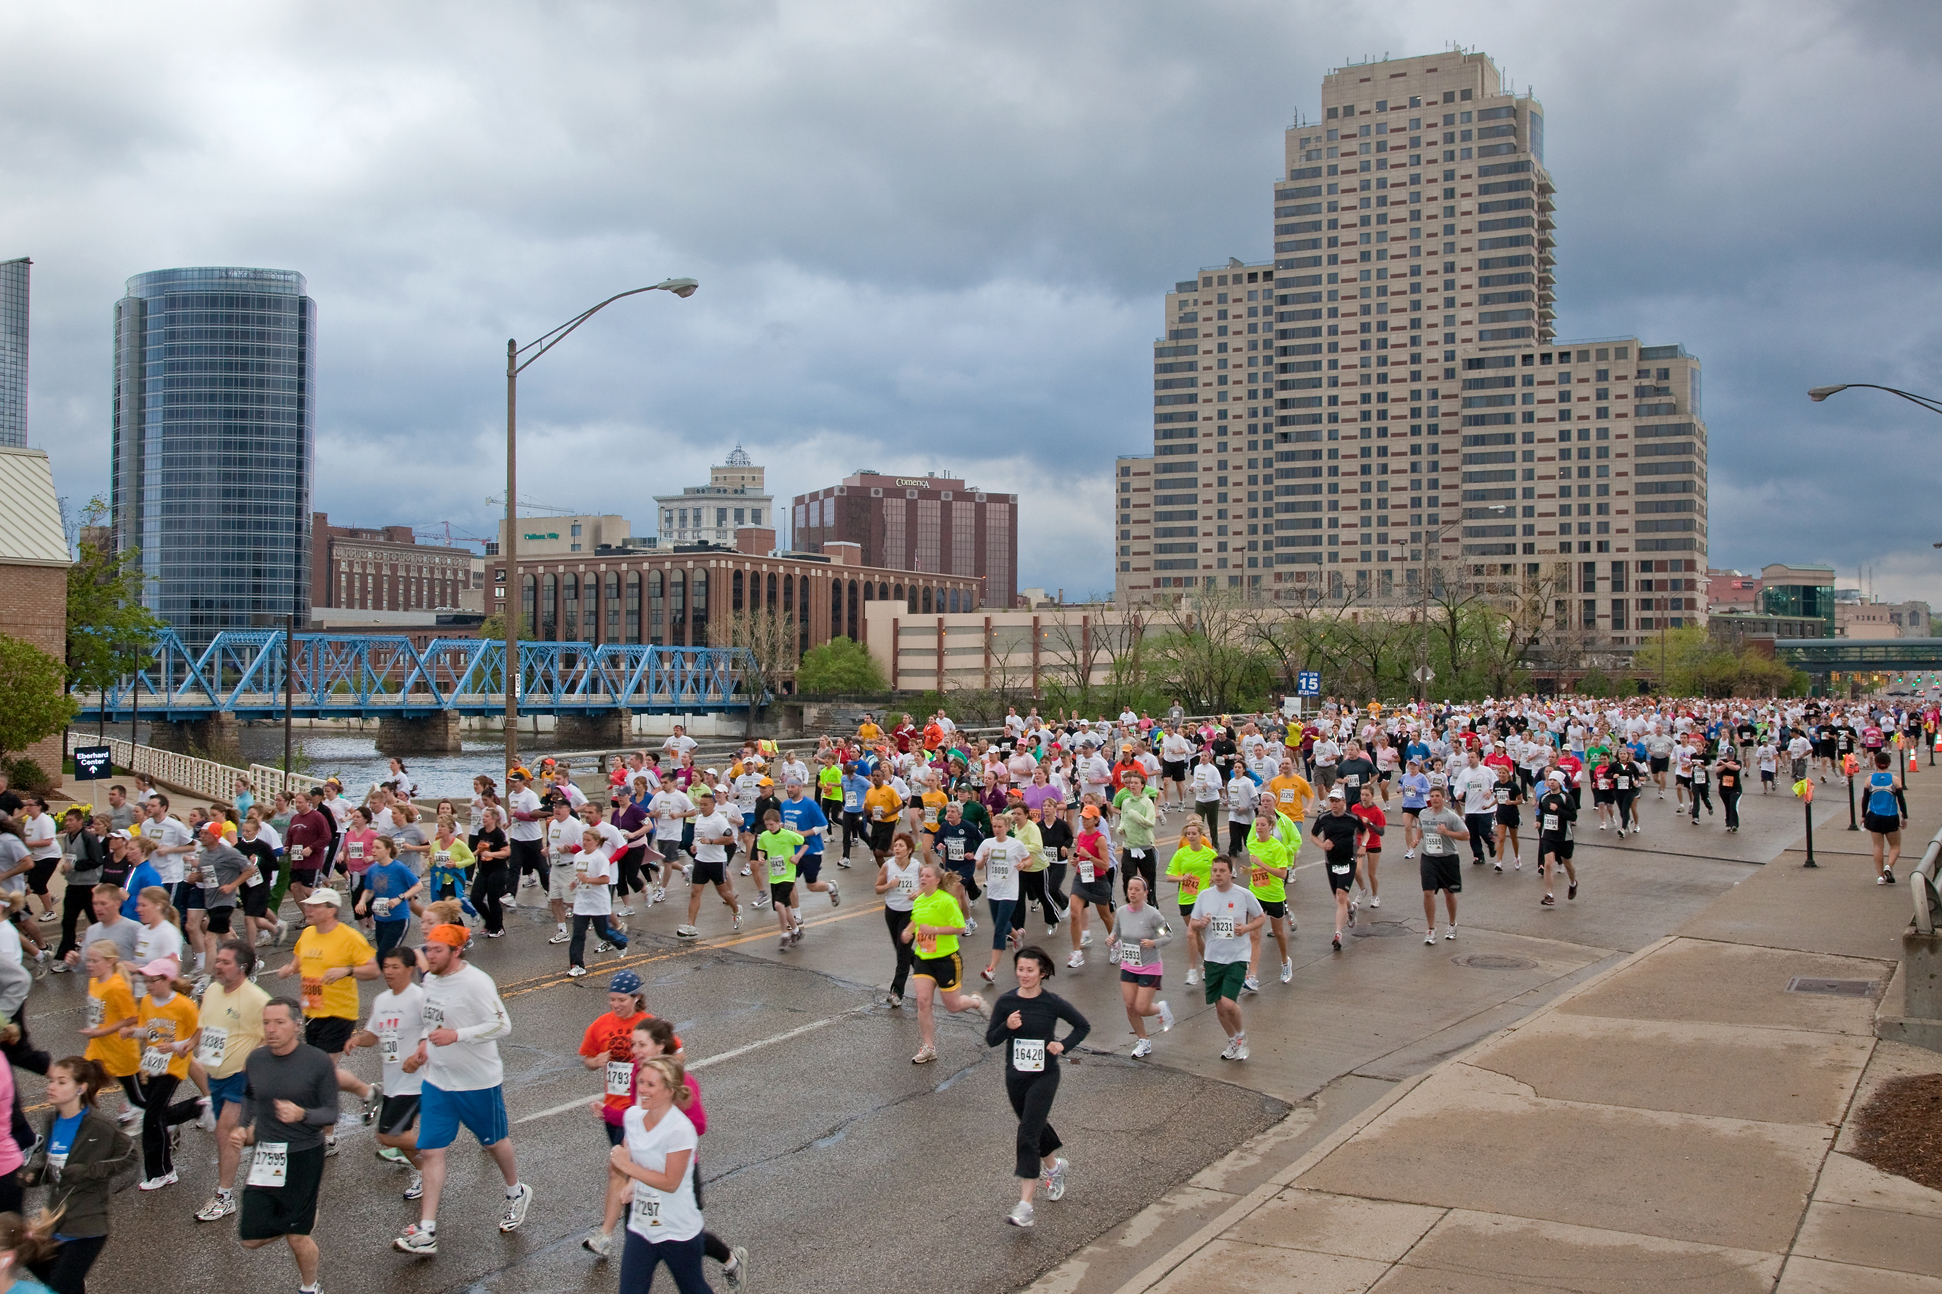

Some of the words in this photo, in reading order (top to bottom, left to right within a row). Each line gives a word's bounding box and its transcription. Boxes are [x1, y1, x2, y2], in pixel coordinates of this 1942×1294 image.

[1299, 677, 1319, 690] 15
[76, 752, 109, 760] Eberhard
[1212, 921, 1233, 932] 18231
[1121, 949, 1140, 960] 15933
[1015, 1048, 1043, 1061] 16420
[255, 1151, 287, 1166] 17595
